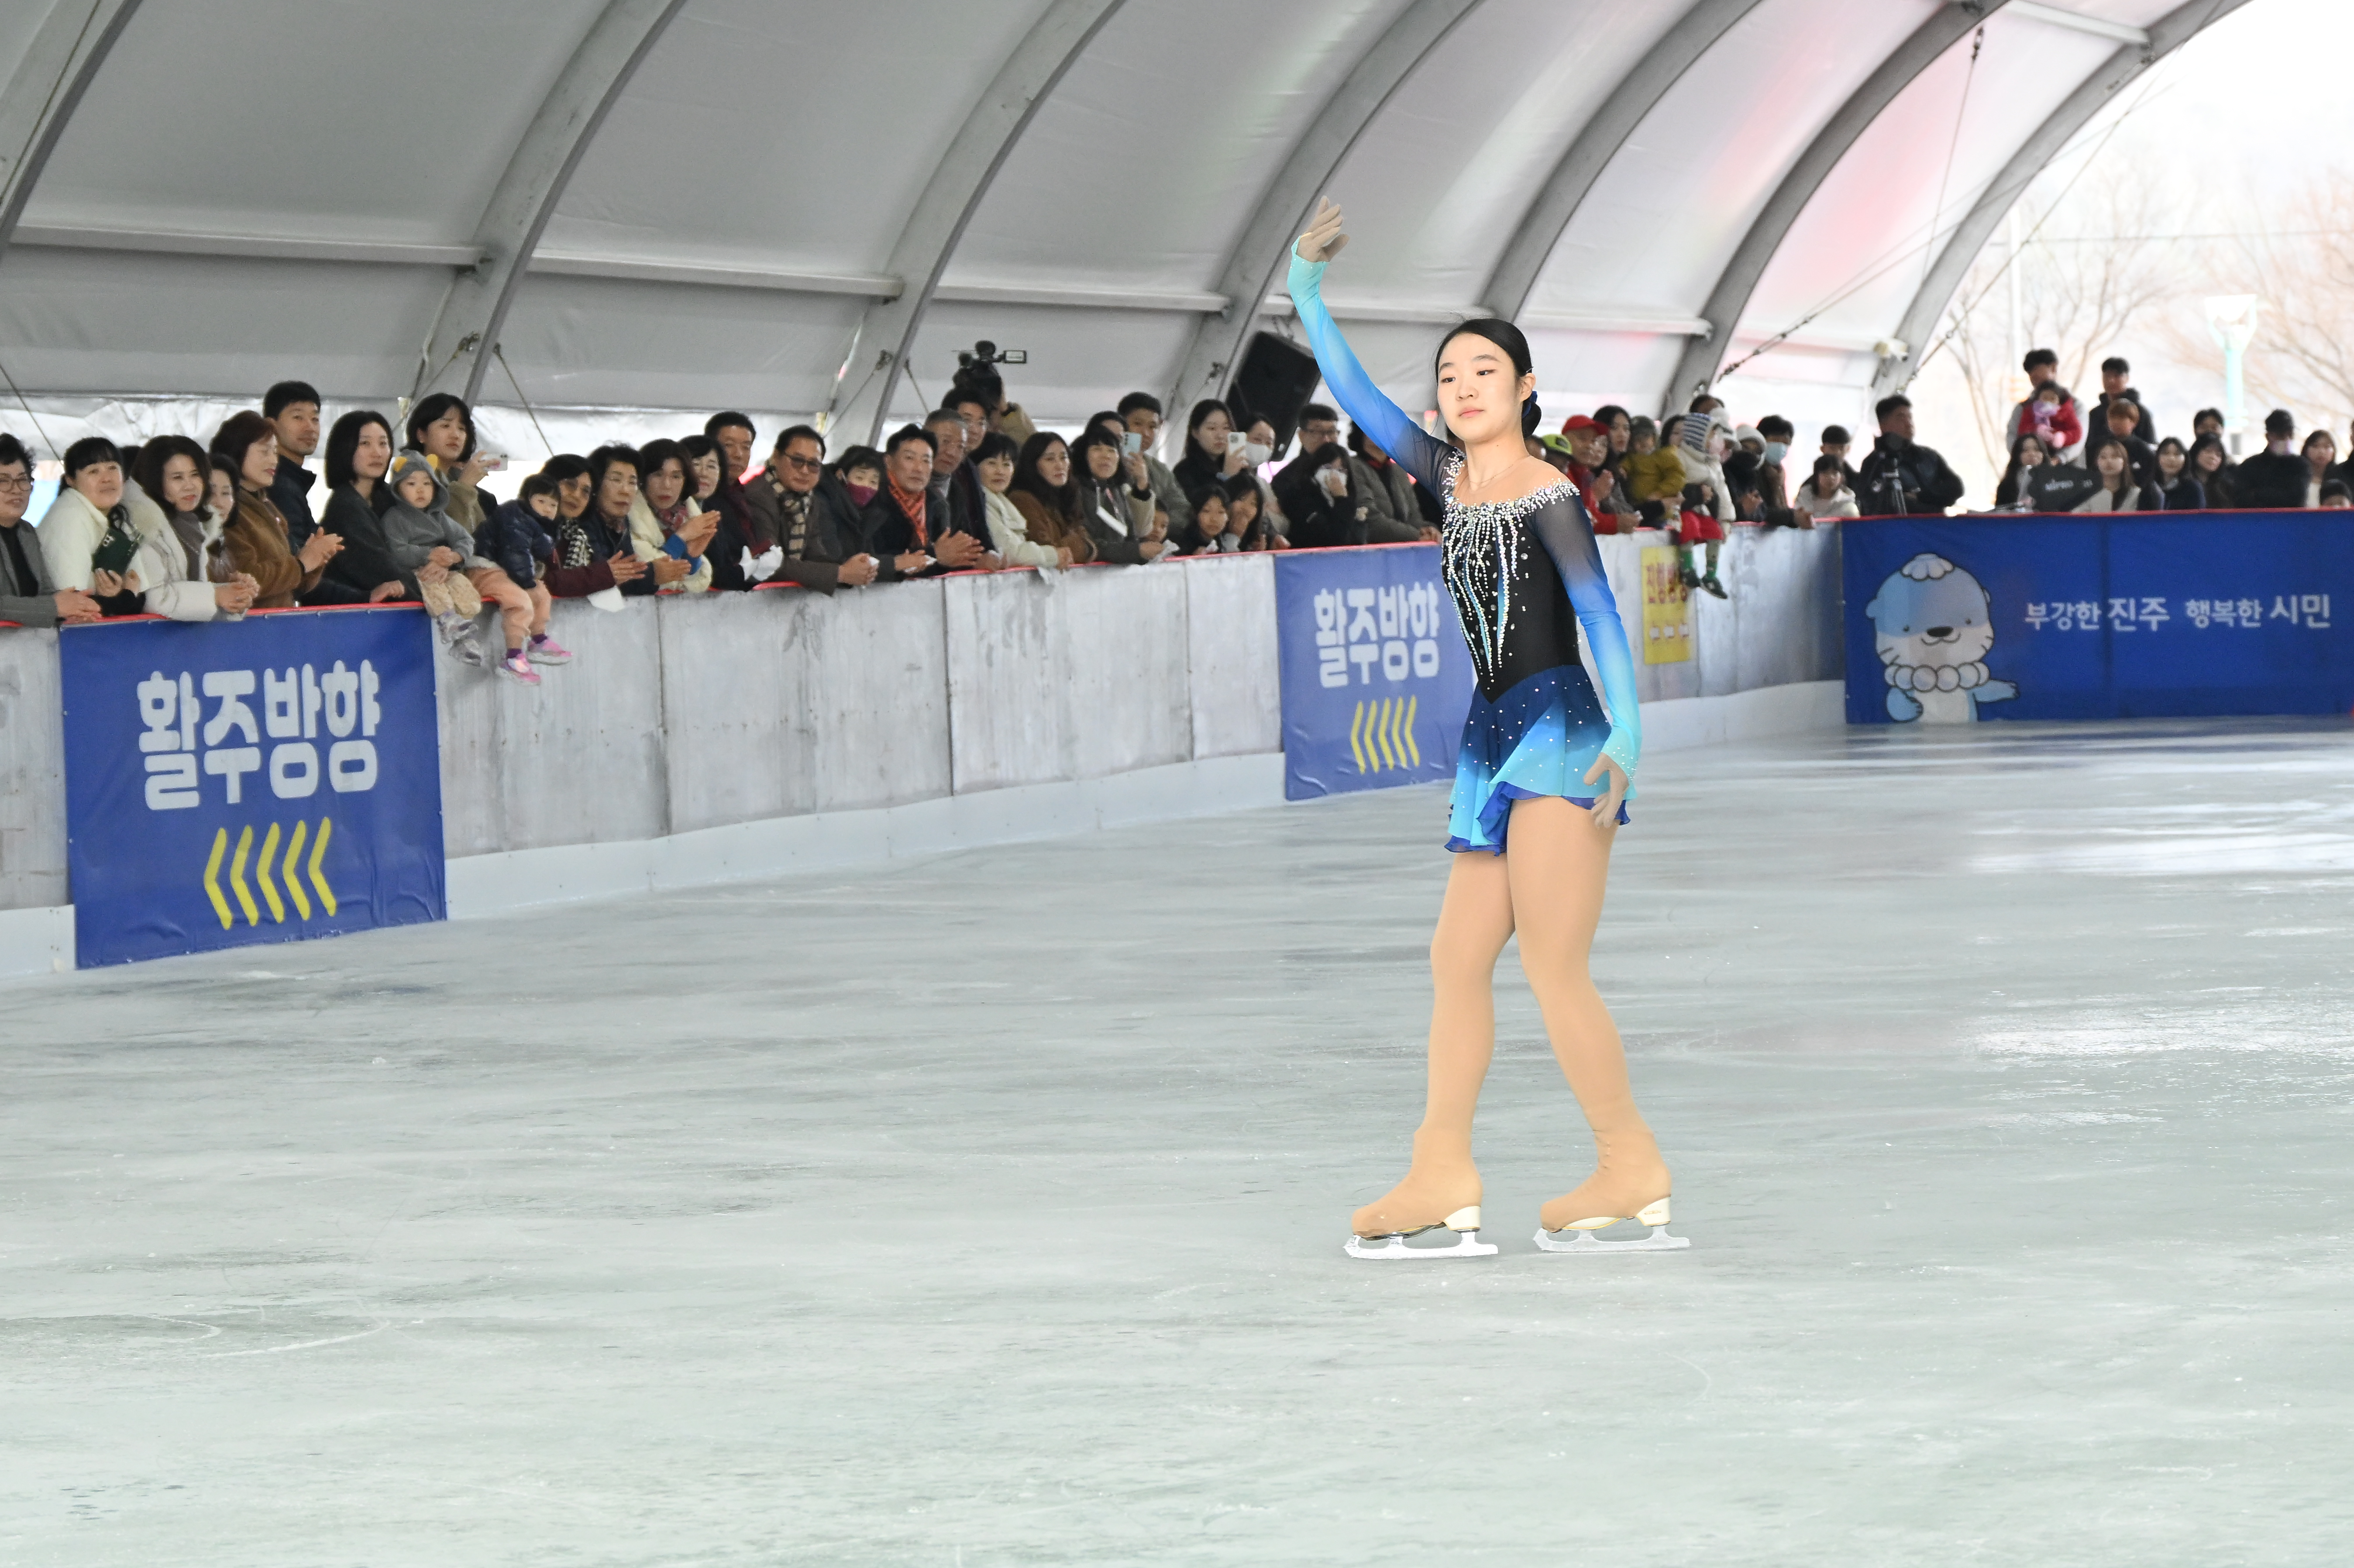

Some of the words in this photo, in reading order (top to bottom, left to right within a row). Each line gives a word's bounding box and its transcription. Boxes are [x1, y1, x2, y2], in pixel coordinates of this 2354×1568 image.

[1314, 582, 1440, 688] 활주방향
[2024, 601, 2102, 631] 부강한
[2108, 597, 2170, 632] 진주
[2185, 598, 2263, 629] 행복한
[2269, 594, 2331, 629] 시민
[137, 659, 381, 811] 활주방향
